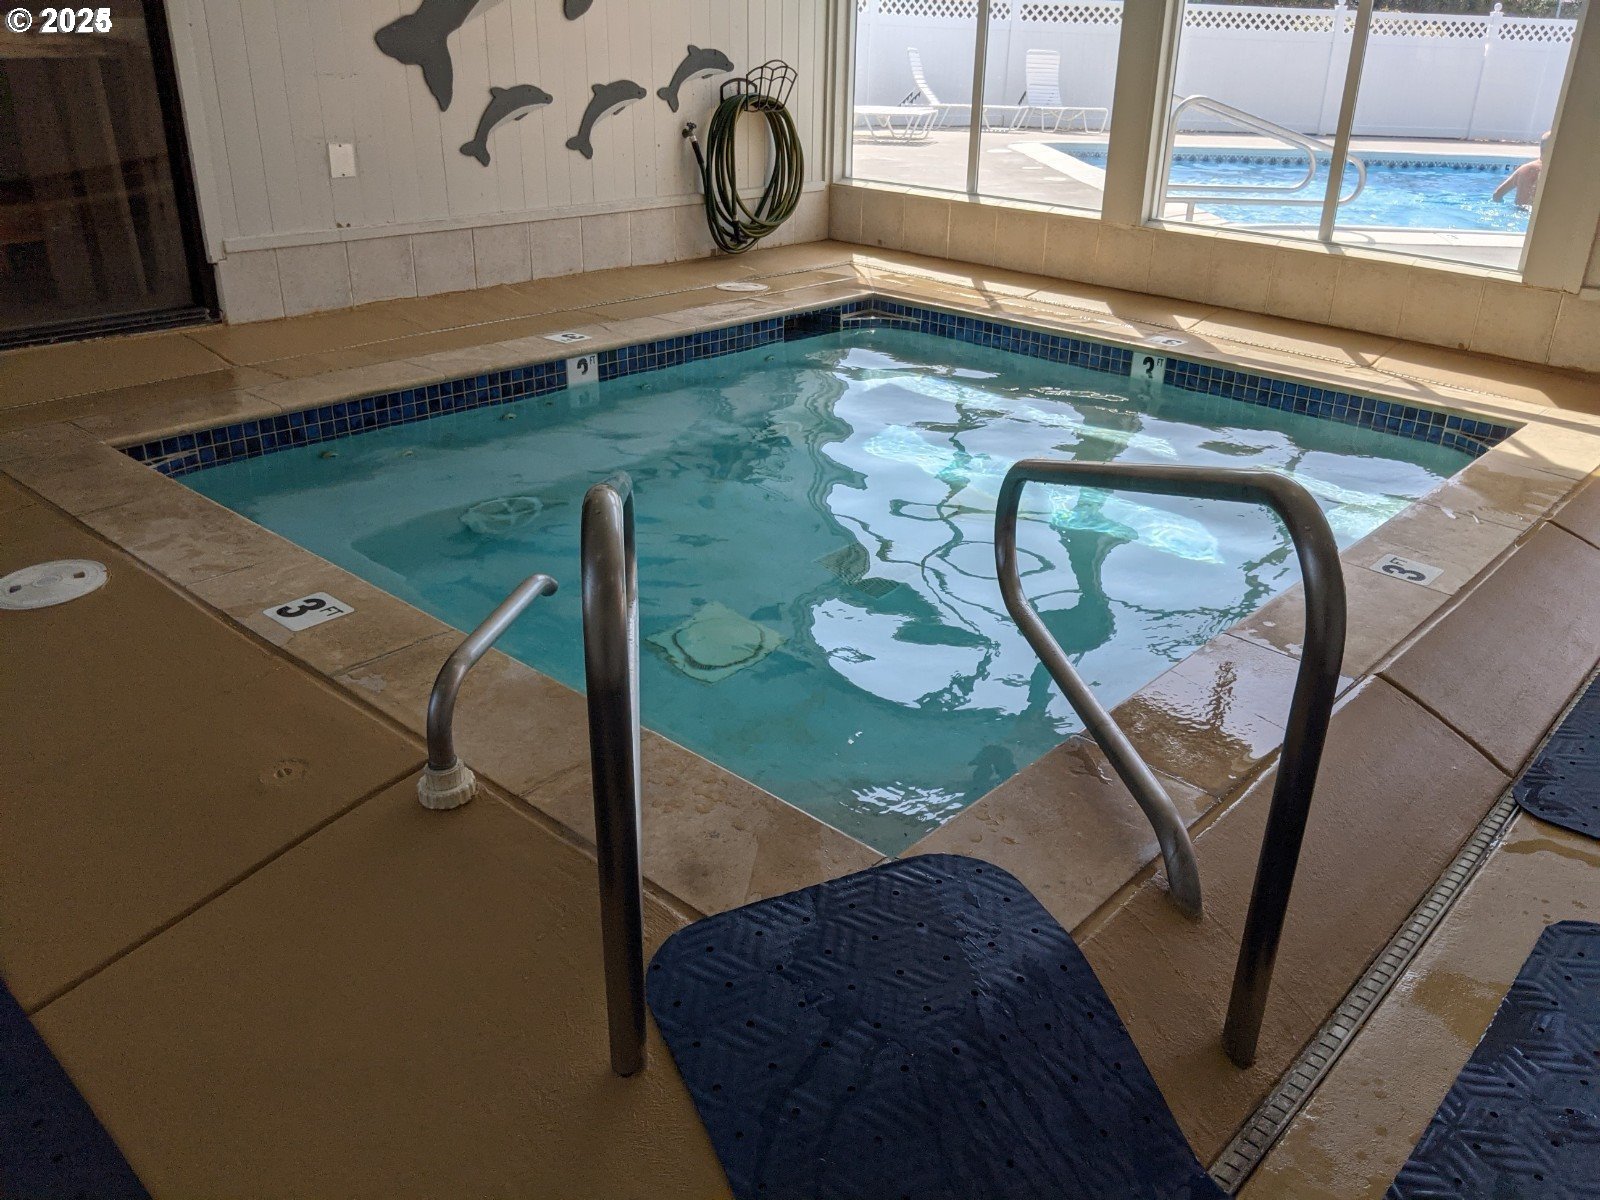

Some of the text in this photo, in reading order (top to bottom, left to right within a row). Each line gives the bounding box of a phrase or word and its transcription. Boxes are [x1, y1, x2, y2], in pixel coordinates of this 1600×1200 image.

[1157, 358, 1164, 367] FT
[1382, 557, 1426, 581] 3 FT
[276, 598, 344, 617] 3 FT
